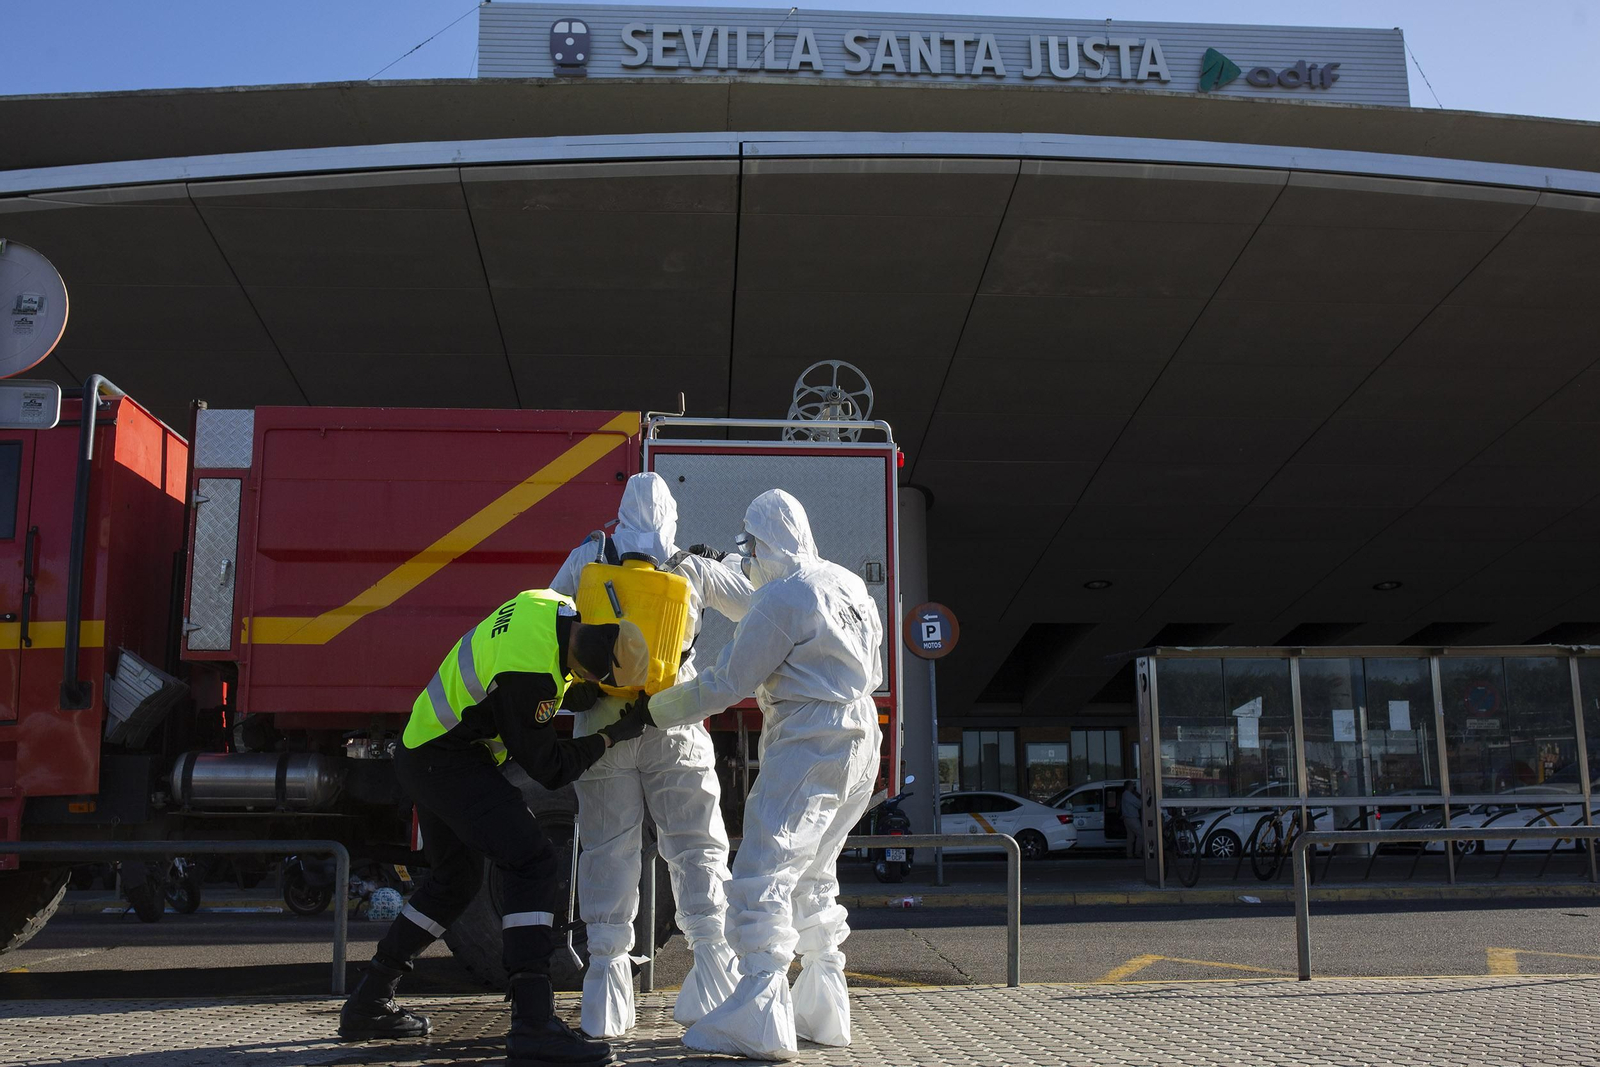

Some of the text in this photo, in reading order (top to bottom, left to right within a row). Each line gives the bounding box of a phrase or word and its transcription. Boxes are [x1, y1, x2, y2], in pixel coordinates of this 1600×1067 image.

[621, 22, 1172, 83] SEVILLA SANTA JUSTA
[1245, 60, 1341, 90] adif
[491, 602, 517, 639] UME
[926, 625, 936, 638] P
